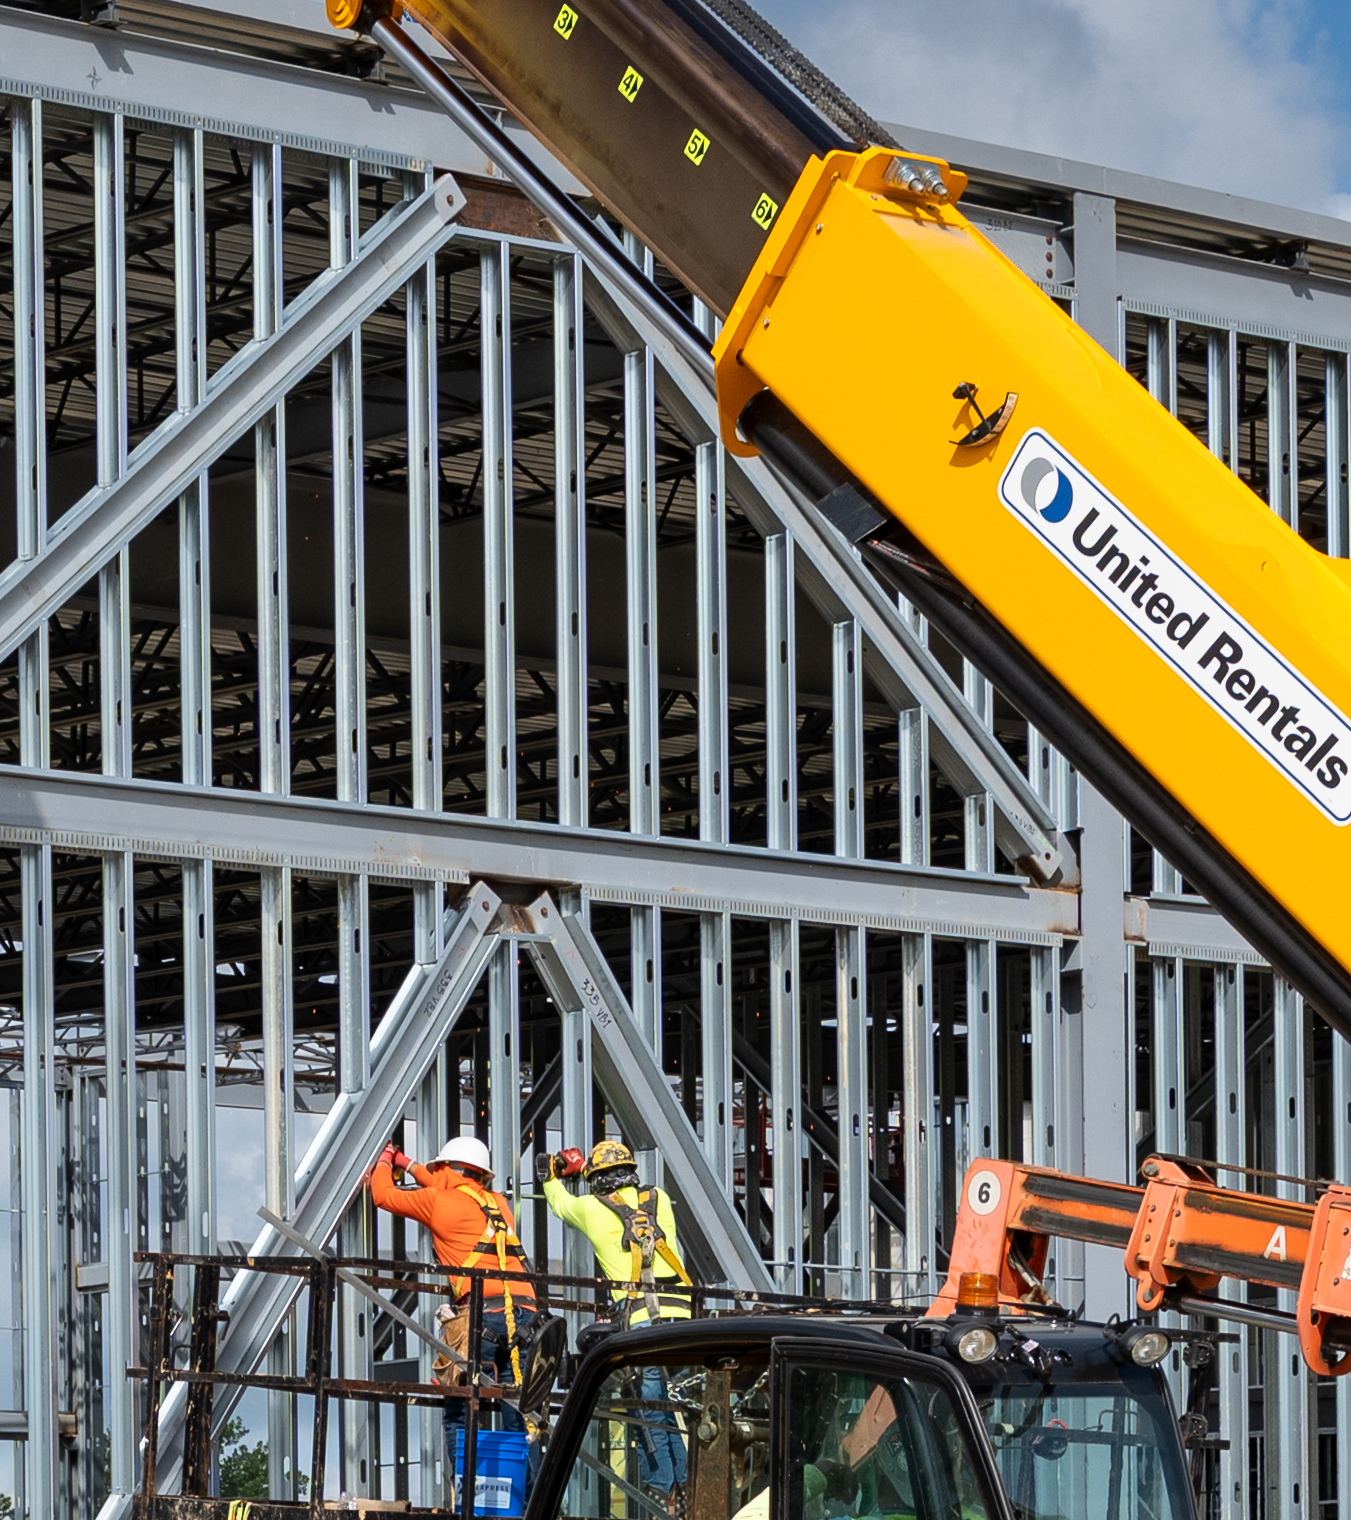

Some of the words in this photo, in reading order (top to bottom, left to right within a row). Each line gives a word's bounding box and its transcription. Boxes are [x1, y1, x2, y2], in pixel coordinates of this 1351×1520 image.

[557, 9, 570, 30] 3
[622, 73, 635, 92] 4
[687, 134, 702, 155] 5
[755, 199, 769, 219] 6
[1071, 506, 1211, 651] United
[1196, 630, 1349, 789] Rentals
[977, 1182, 991, 1204] 6
[1263, 1225, 1288, 1262] A
